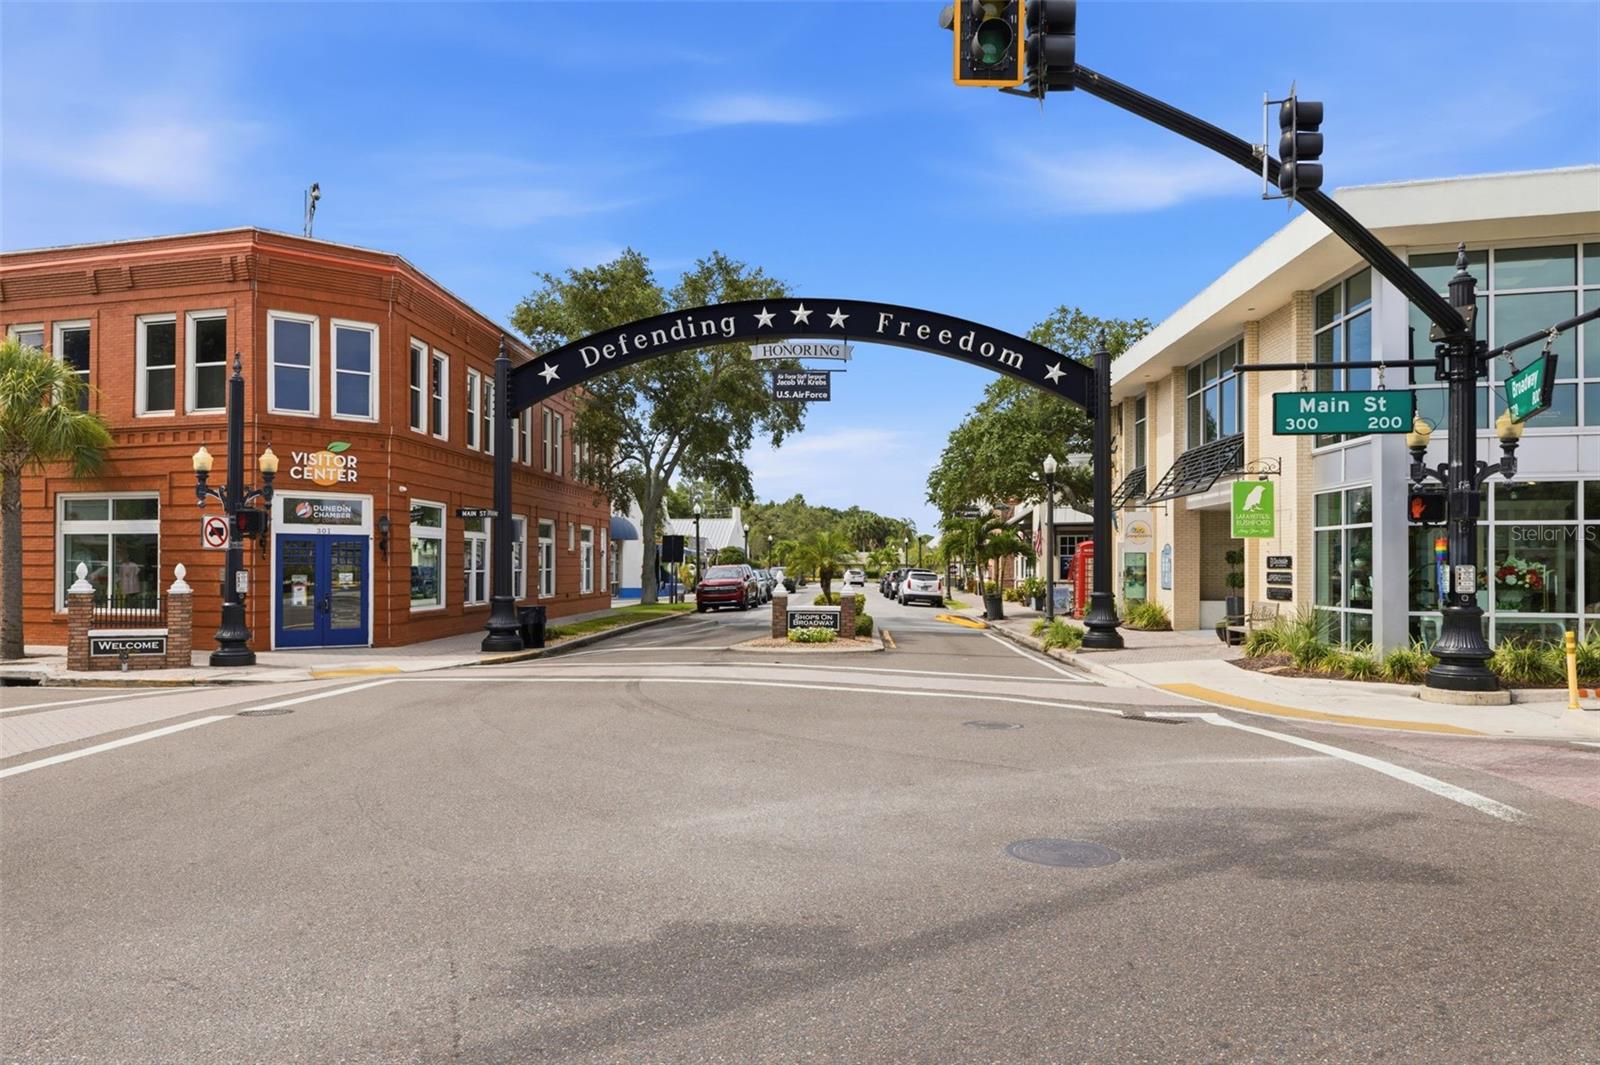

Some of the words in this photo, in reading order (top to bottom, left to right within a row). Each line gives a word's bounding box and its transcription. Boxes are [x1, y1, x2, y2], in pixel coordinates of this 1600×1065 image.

[579, 316, 735, 368] Defending
[876, 312, 1024, 370] Freedom
[763, 345, 840, 357] HONORING
[1512, 370, 1539, 398] Broadway
[1300, 397, 1349, 413] Main
[1364, 396, 1387, 412] St
[1285, 418, 1318, 430] 300
[1368, 417, 1402, 429] 200
[291, 451, 357, 468] VISITOR
[290, 466, 357, 482] CENTER
[98, 641, 160, 650] WELCOME
